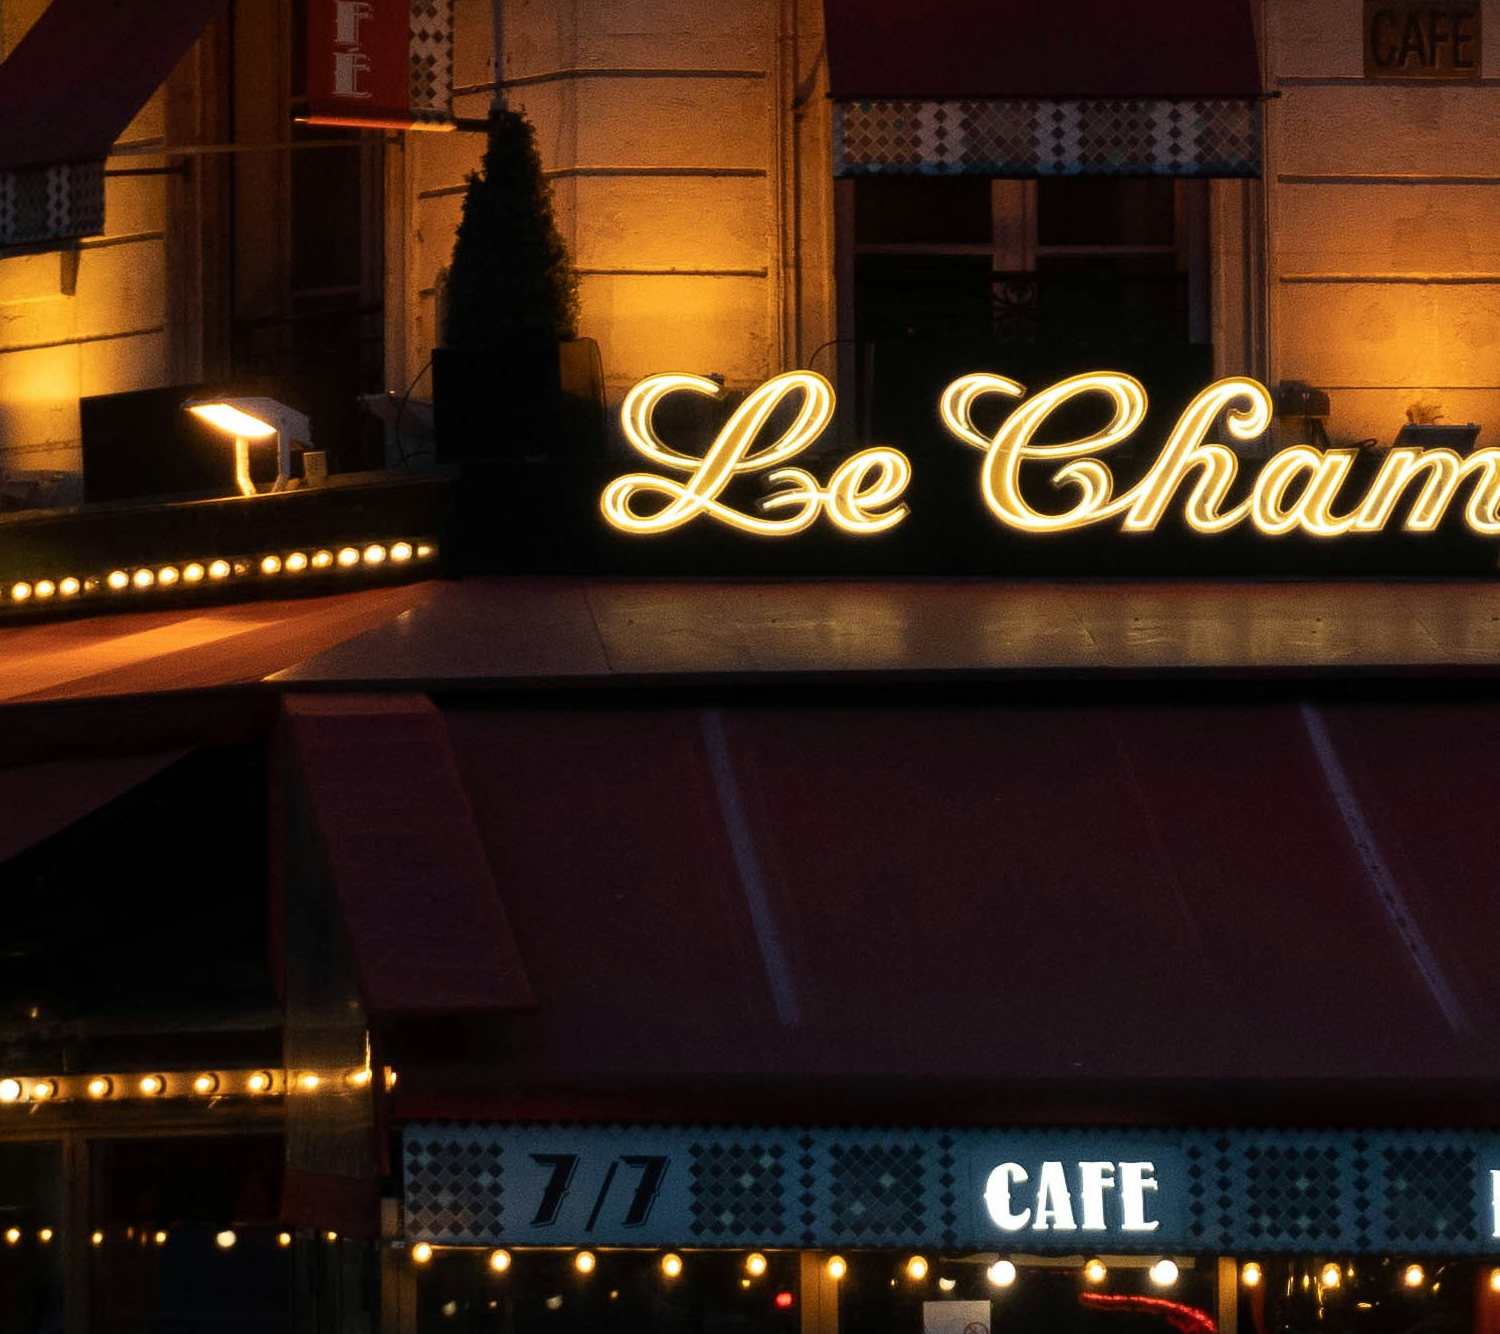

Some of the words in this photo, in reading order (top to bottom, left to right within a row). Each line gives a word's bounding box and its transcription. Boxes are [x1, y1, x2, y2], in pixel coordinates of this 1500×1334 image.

[1370, 7, 1475, 68] CAFE
[601, 369, 913, 536] Le
[529, 1153, 672, 1233] 7/7
[984, 1161, 1161, 1231] CAFE
